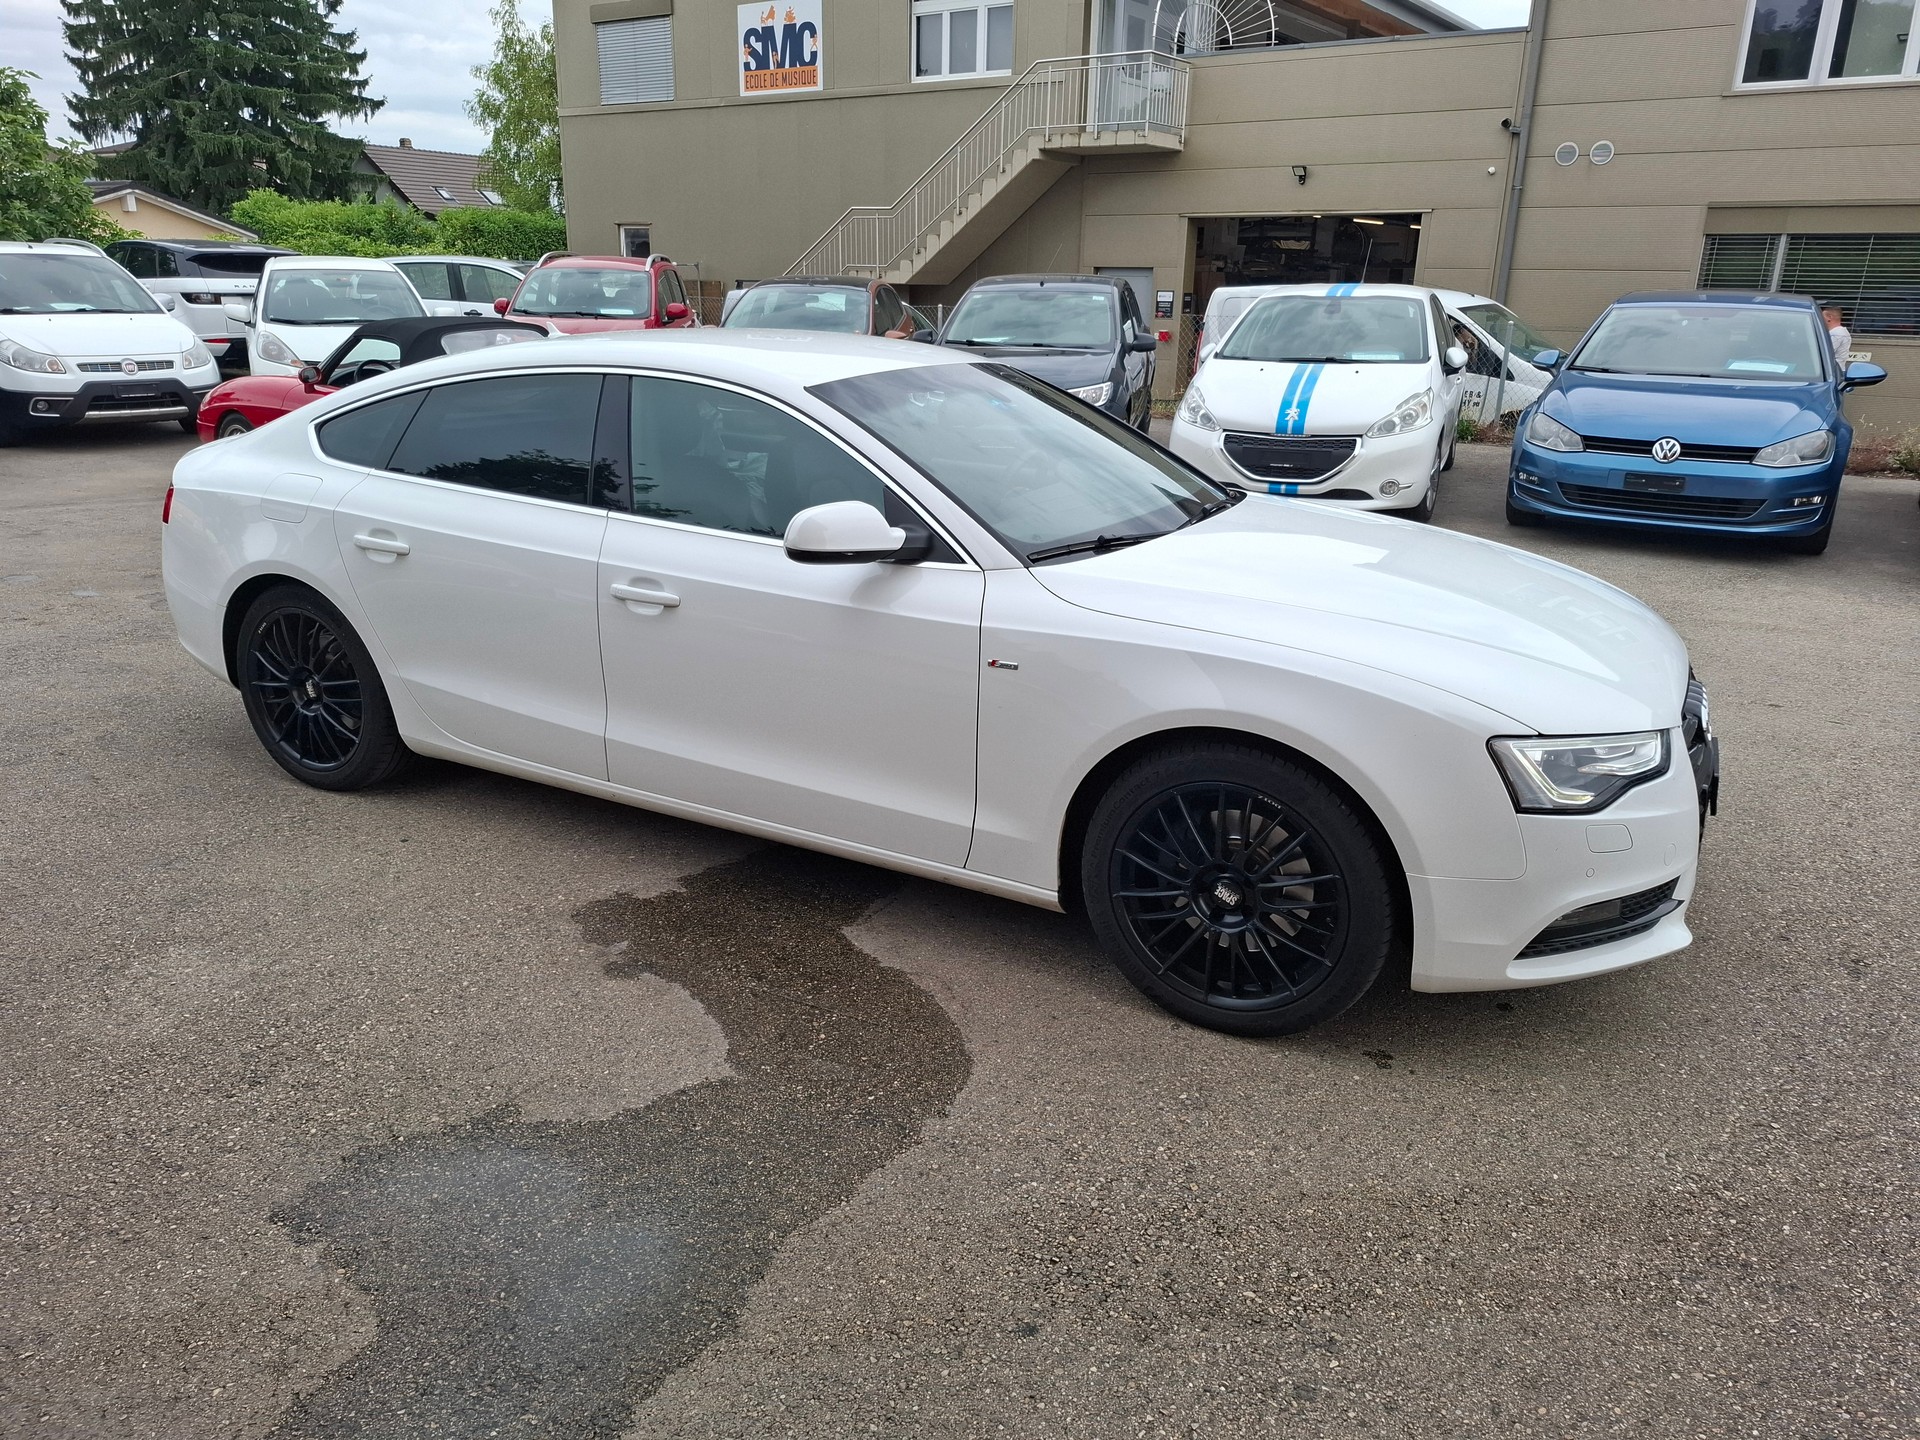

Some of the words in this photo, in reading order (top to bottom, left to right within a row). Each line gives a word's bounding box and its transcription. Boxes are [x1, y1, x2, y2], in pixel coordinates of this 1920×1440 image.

[743, 21, 818, 71] SMC
[745, 73, 767, 89] ECOLE
[769, 72, 779, 87] DE
[781, 69, 817, 87] MUSIQUE
